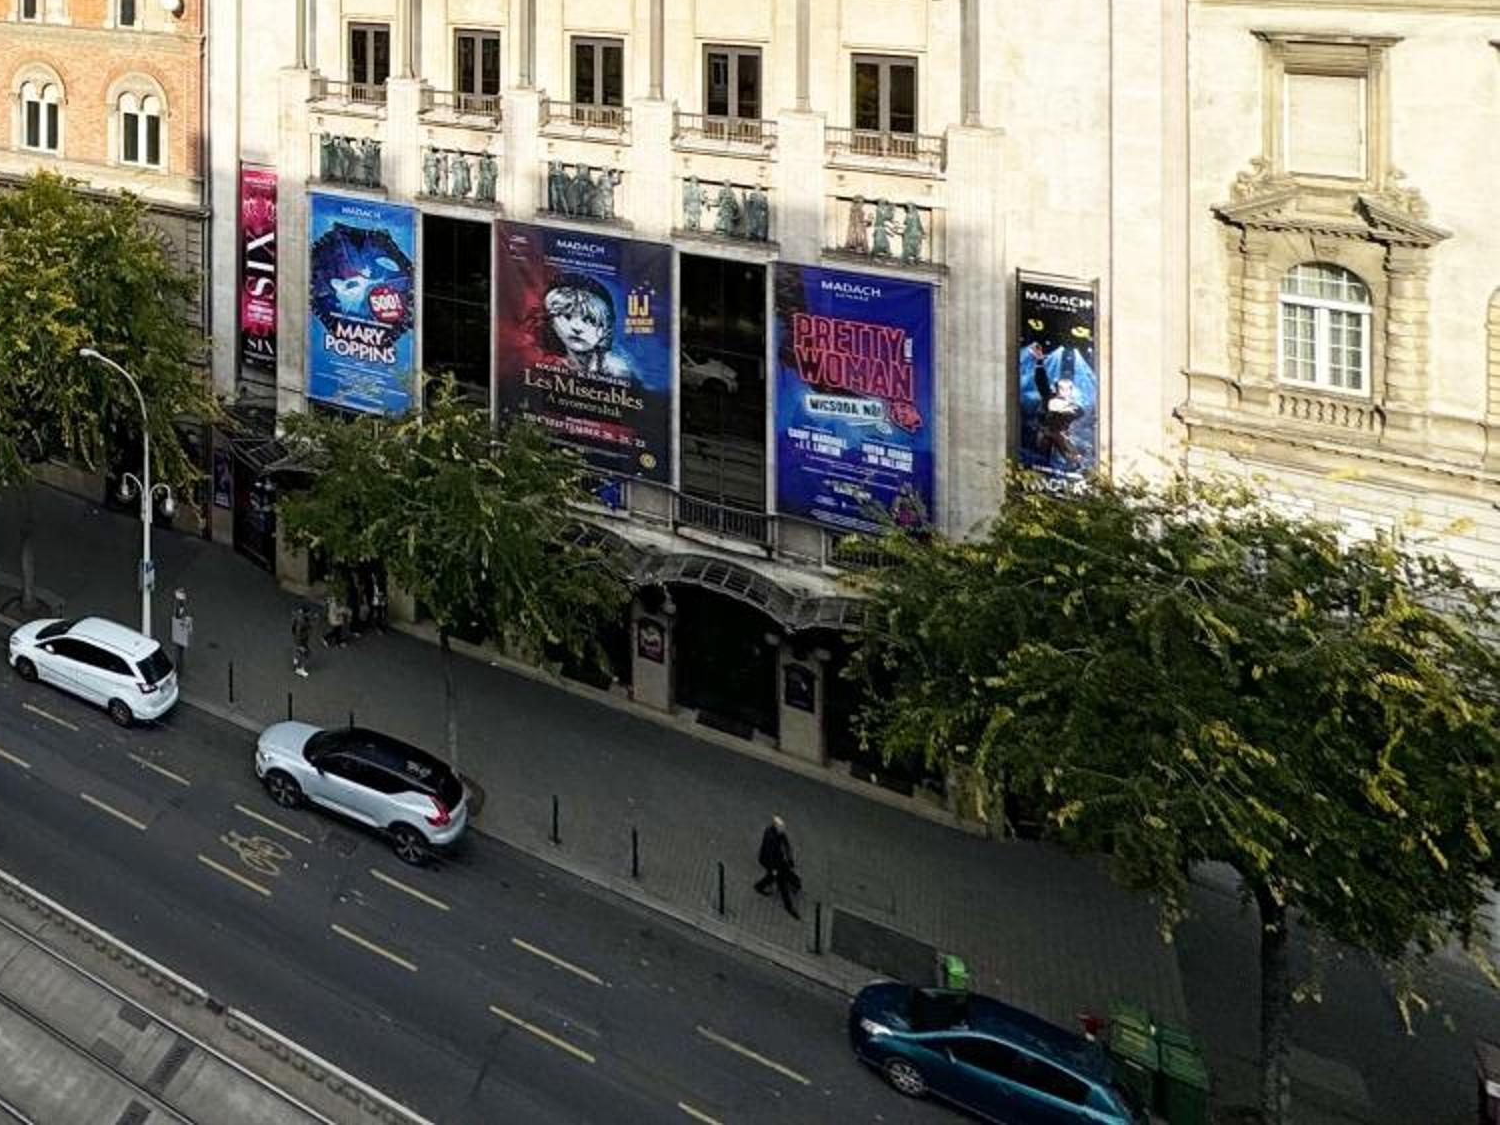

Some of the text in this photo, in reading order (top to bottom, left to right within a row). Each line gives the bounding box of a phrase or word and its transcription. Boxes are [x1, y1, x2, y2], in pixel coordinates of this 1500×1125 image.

[246, 229, 276, 300] SIX
[325, 334, 396, 364] POPPINS
[336, 322, 385, 346] MARY
[793, 312, 905, 363] PRETTY
[794, 344, 915, 402] WOMAN
